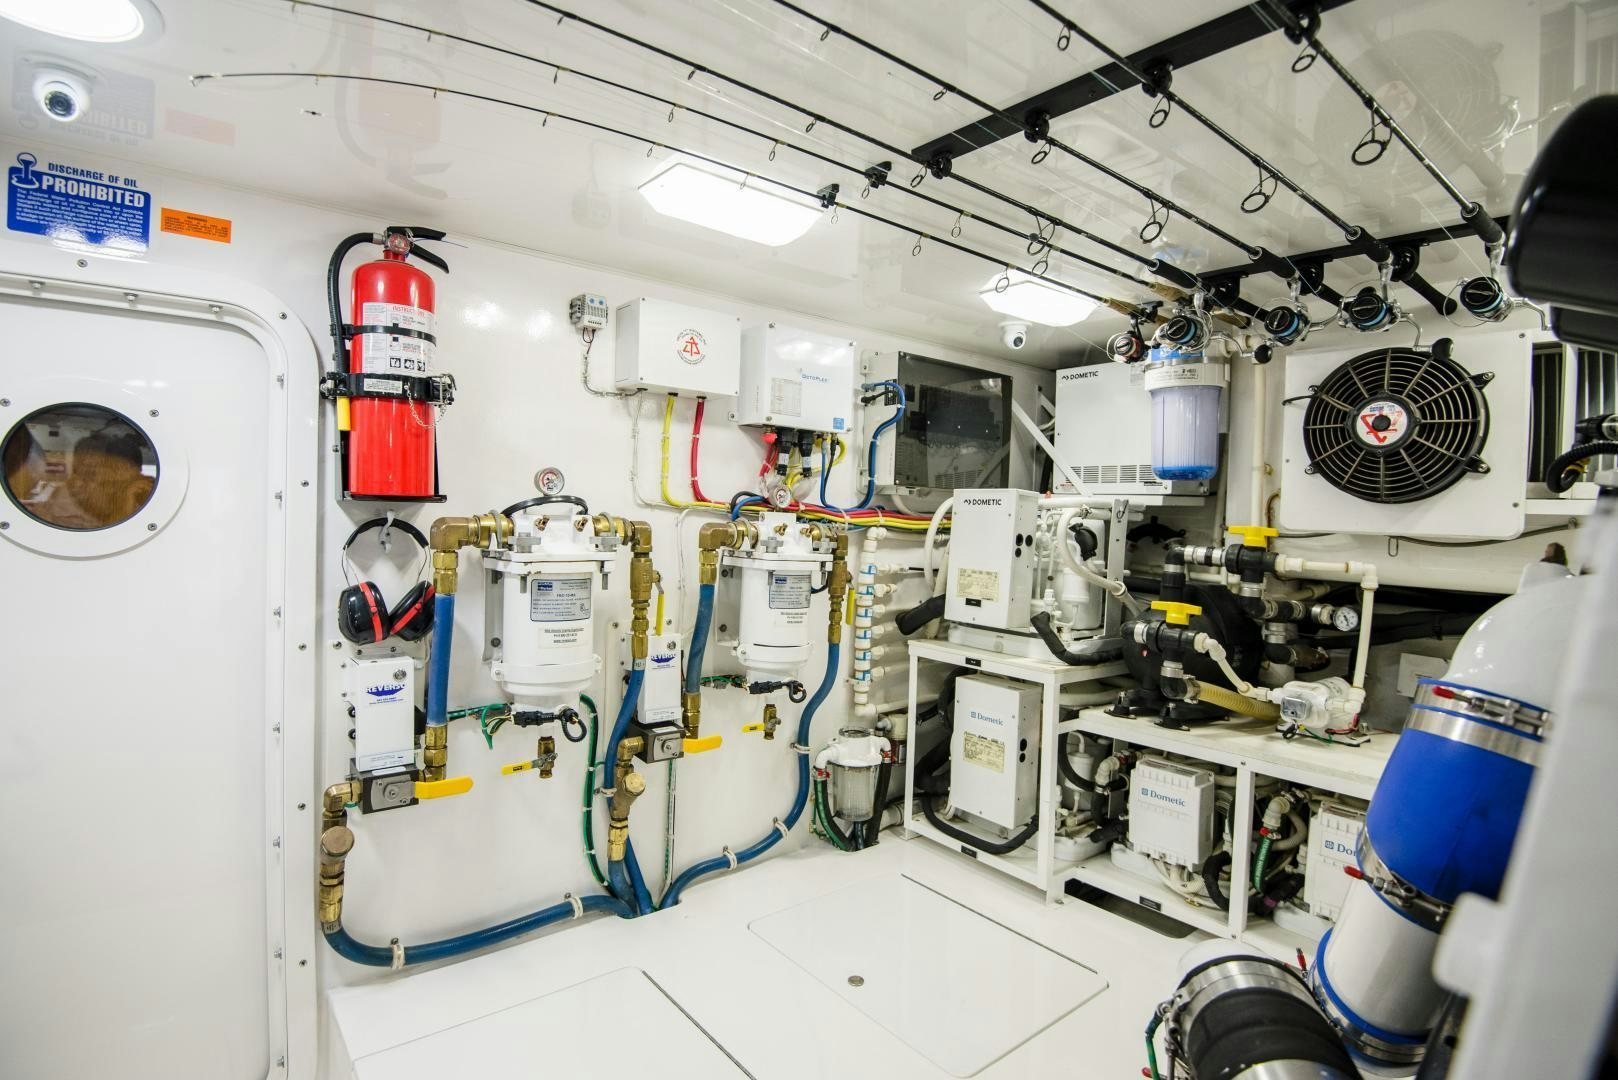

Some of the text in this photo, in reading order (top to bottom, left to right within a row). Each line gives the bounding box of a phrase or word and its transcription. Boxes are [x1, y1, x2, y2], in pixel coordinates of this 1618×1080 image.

[48, 163, 138, 188] DISCHARGE OF OIL
[41, 175, 145, 207] PROHIBITED
[1070, 370, 1099, 380] DOMETIC
[977, 712, 1004, 726] Dometic
[1150, 789, 1185, 807] Dometic
